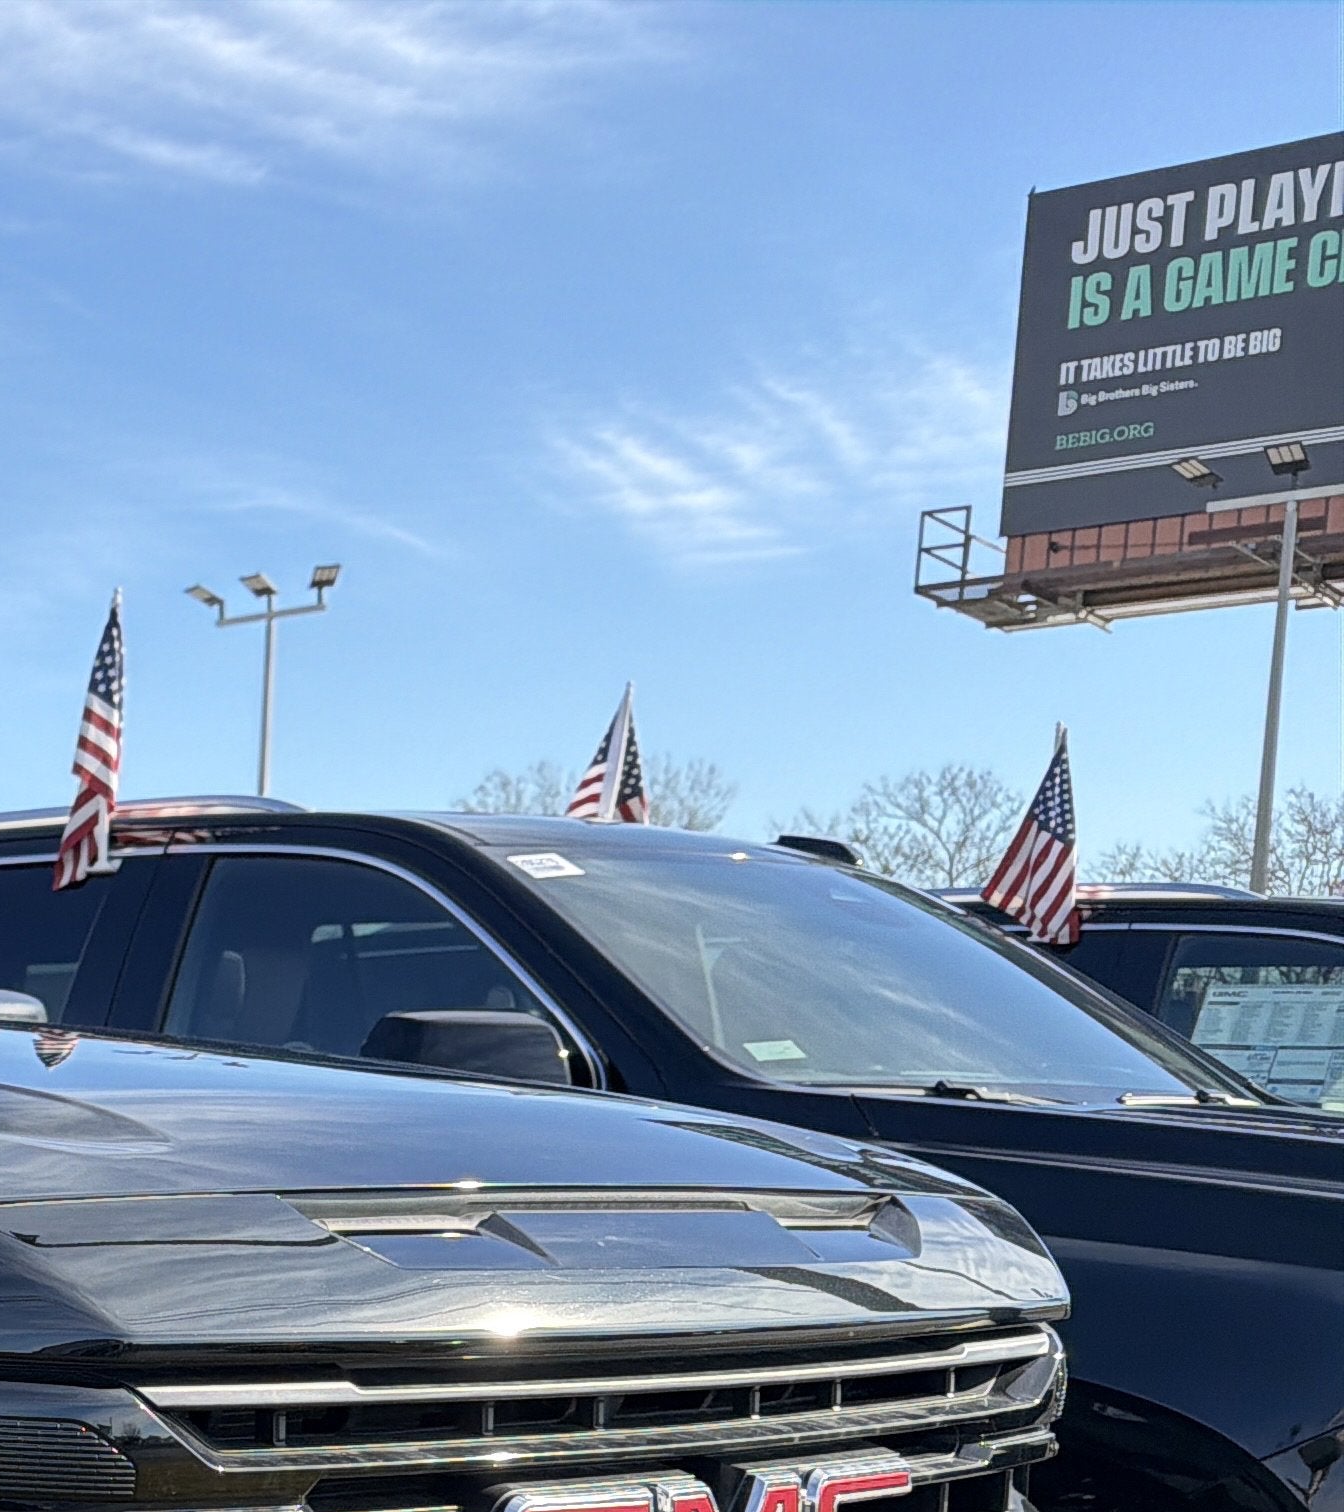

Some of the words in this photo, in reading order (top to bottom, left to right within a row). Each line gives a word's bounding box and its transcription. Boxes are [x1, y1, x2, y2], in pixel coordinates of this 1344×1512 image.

[1071, 190, 1195, 264] JUST
[1067, 271, 1112, 329] IS
[1120, 264, 1152, 321] A
[1163, 236, 1298, 312] GAME
[1307, 230, 1344, 288] C
[1059, 361, 1078, 386] IT
[1079, 352, 1134, 383] TAKES
[1137, 342, 1194, 371] LITTLE
[1197, 337, 1220, 364] TO
[1222, 333, 1247, 360] BE
[1248, 328, 1283, 355] BIG
[1080, 394, 1097, 406] Big
[1141, 383, 1158, 397] Big
[1054, 421, 1155, 450] BEBIG.ORG
